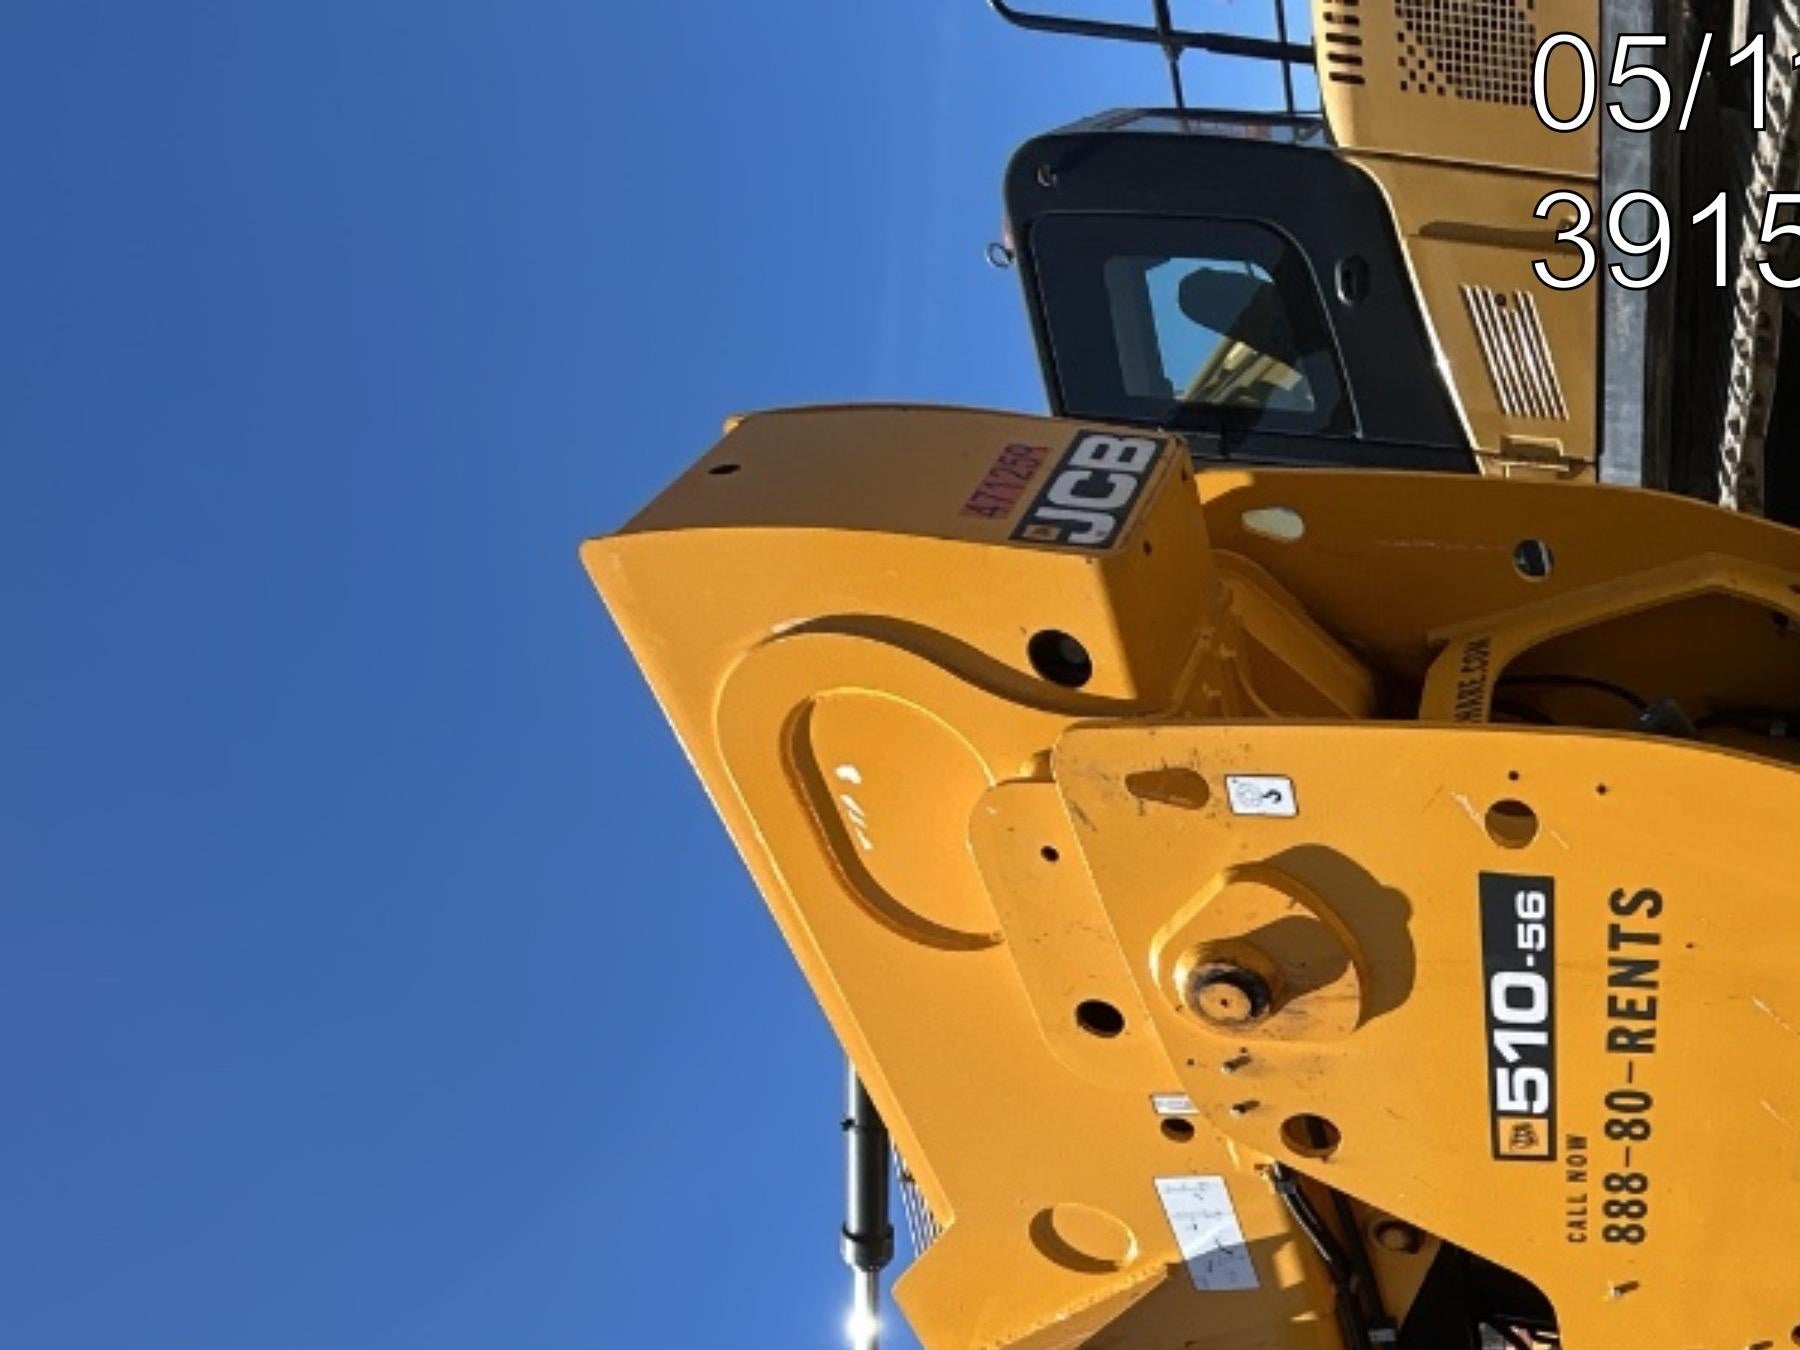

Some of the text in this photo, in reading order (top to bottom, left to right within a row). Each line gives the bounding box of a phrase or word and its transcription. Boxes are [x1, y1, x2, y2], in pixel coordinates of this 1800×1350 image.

[1033, 433, 1157, 543] JCB
[1601, 886, 1663, 1244] 888-80-RENTS
[1566, 1133, 1588, 1243] CALL NOW
